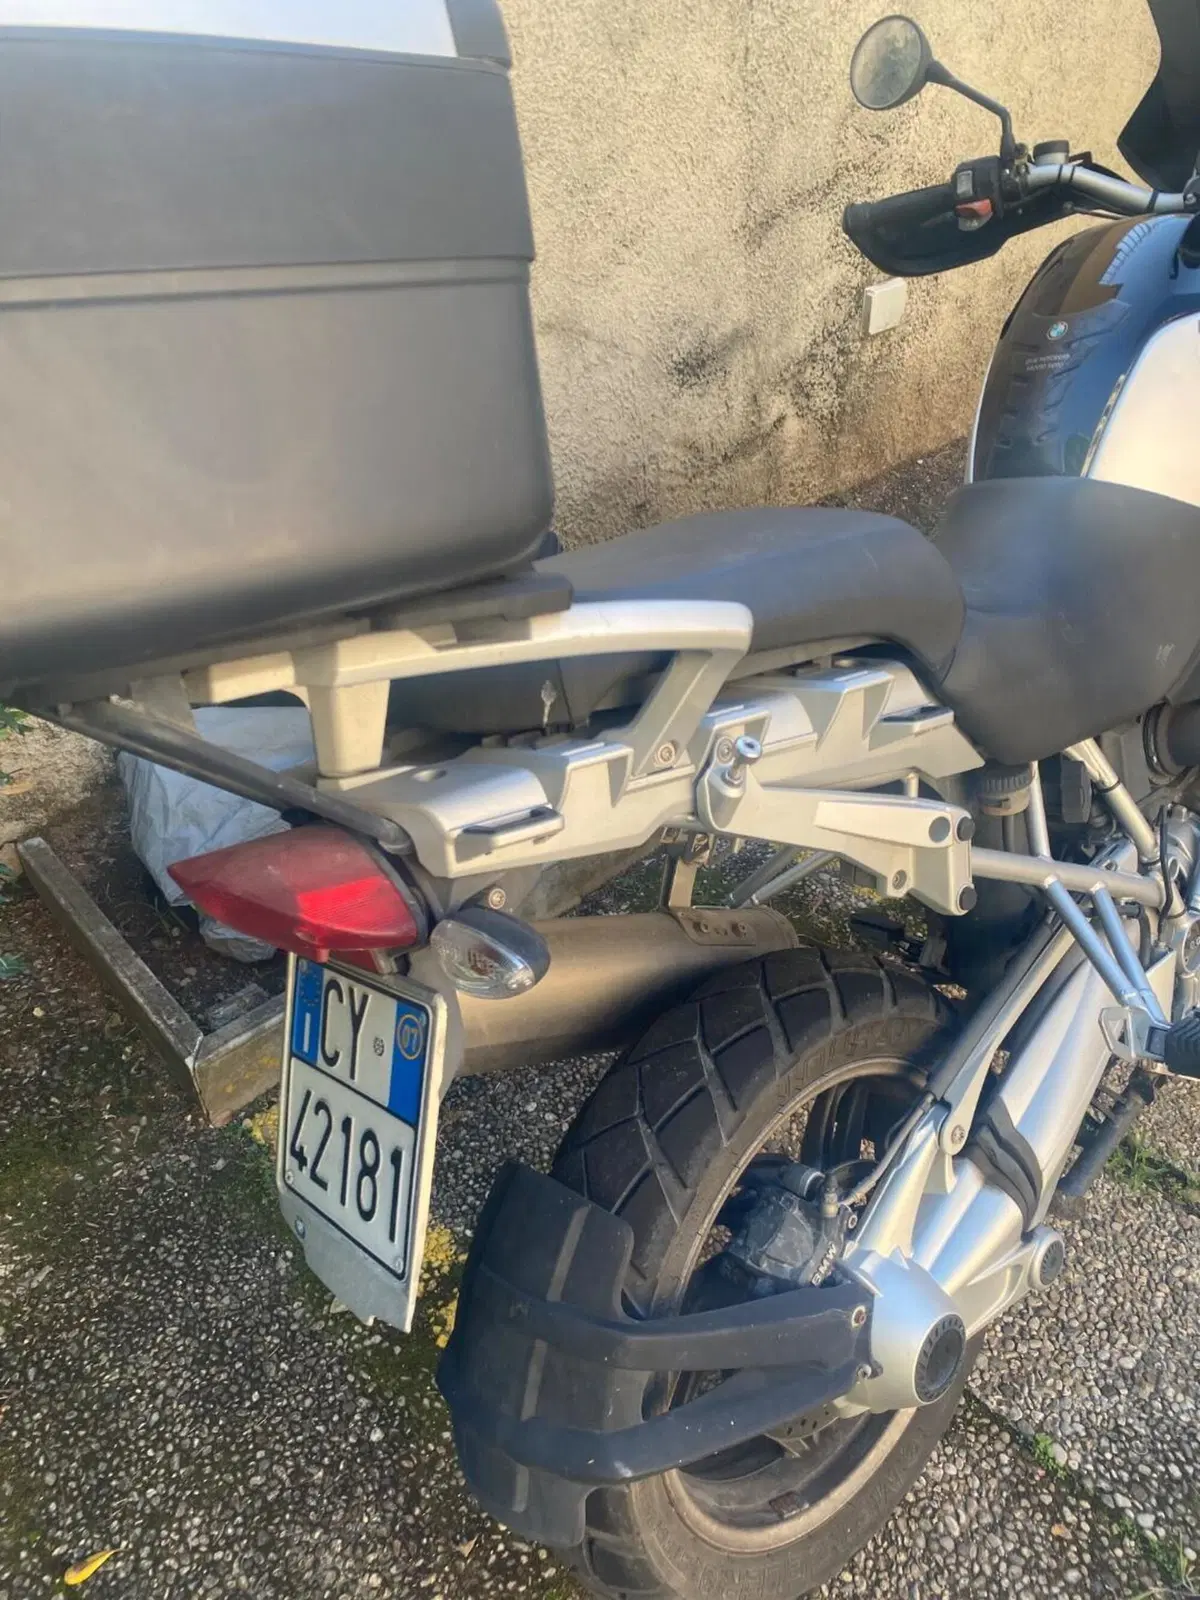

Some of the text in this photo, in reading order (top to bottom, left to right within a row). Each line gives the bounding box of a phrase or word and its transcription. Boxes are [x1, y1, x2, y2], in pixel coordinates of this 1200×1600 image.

[320, 978, 369, 1081] CY
[290, 1089, 402, 1244] 42181
[811, 1241, 837, 1286] BMW
